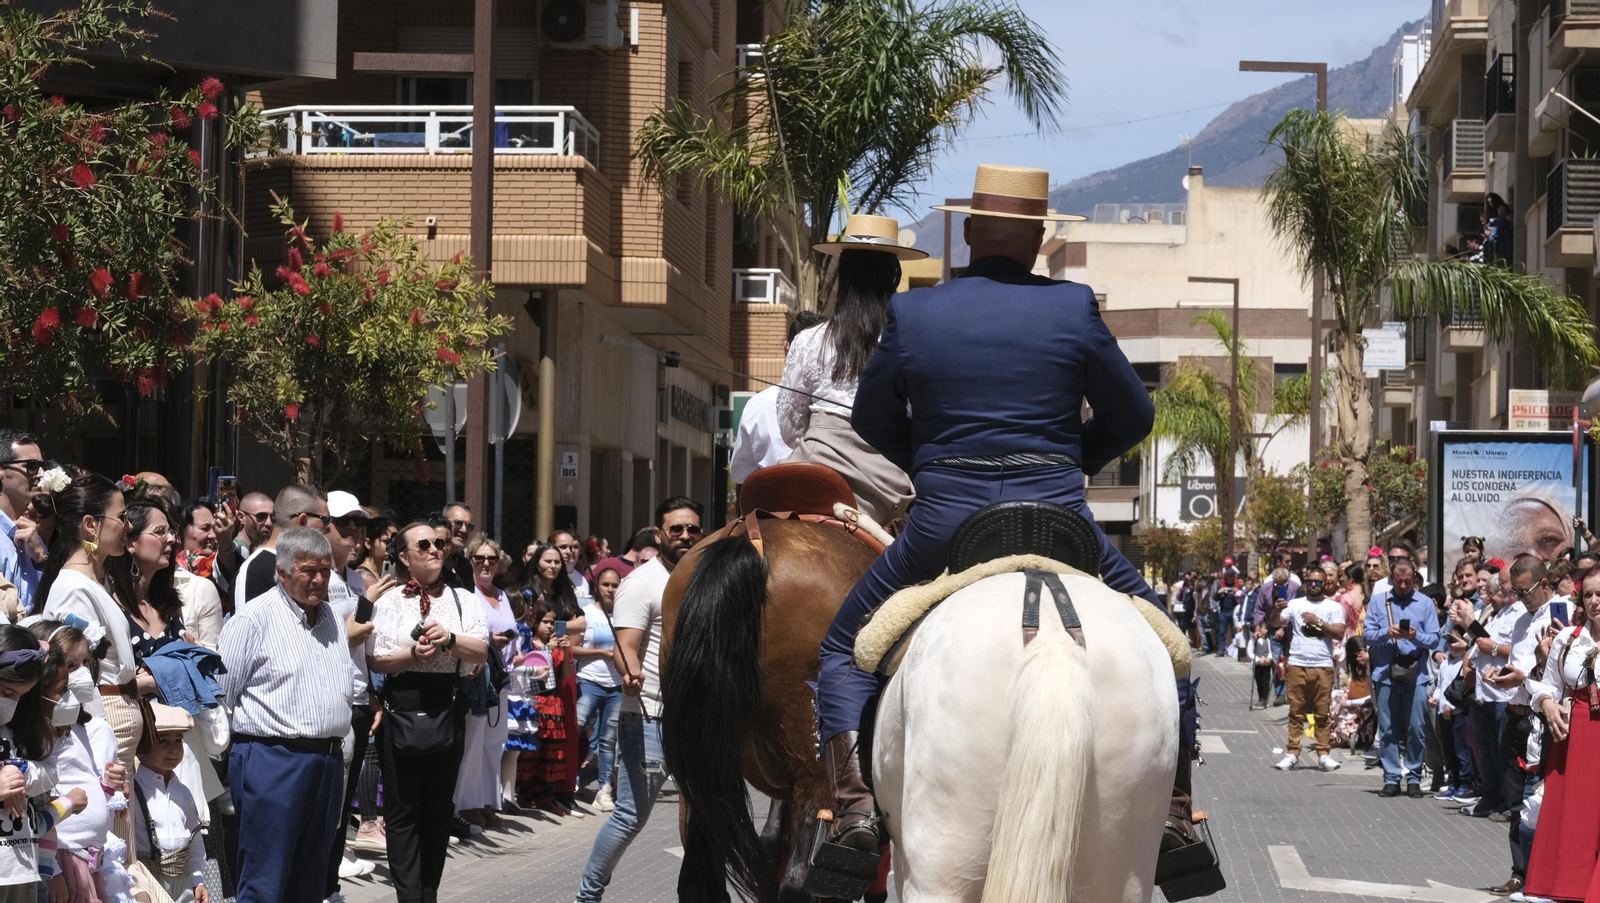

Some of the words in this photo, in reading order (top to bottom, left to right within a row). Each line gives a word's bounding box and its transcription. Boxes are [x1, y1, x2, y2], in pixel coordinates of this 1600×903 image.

[1512, 405, 1574, 414] PSICOLOG
[1528, 420, 1541, 428] 609
[568, 455, 573, 463] 5
[562, 468, 576, 477] BIS
[1452, 469, 1495, 480] NUESTRA
[1497, 470, 1562, 480] INDIFERENCIA
[1451, 481, 1470, 491] LOS
[1472, 482, 1517, 491] CONDENA
[1451, 493, 1463, 502] AL
[1465, 493, 1500, 503] OLVIDO
